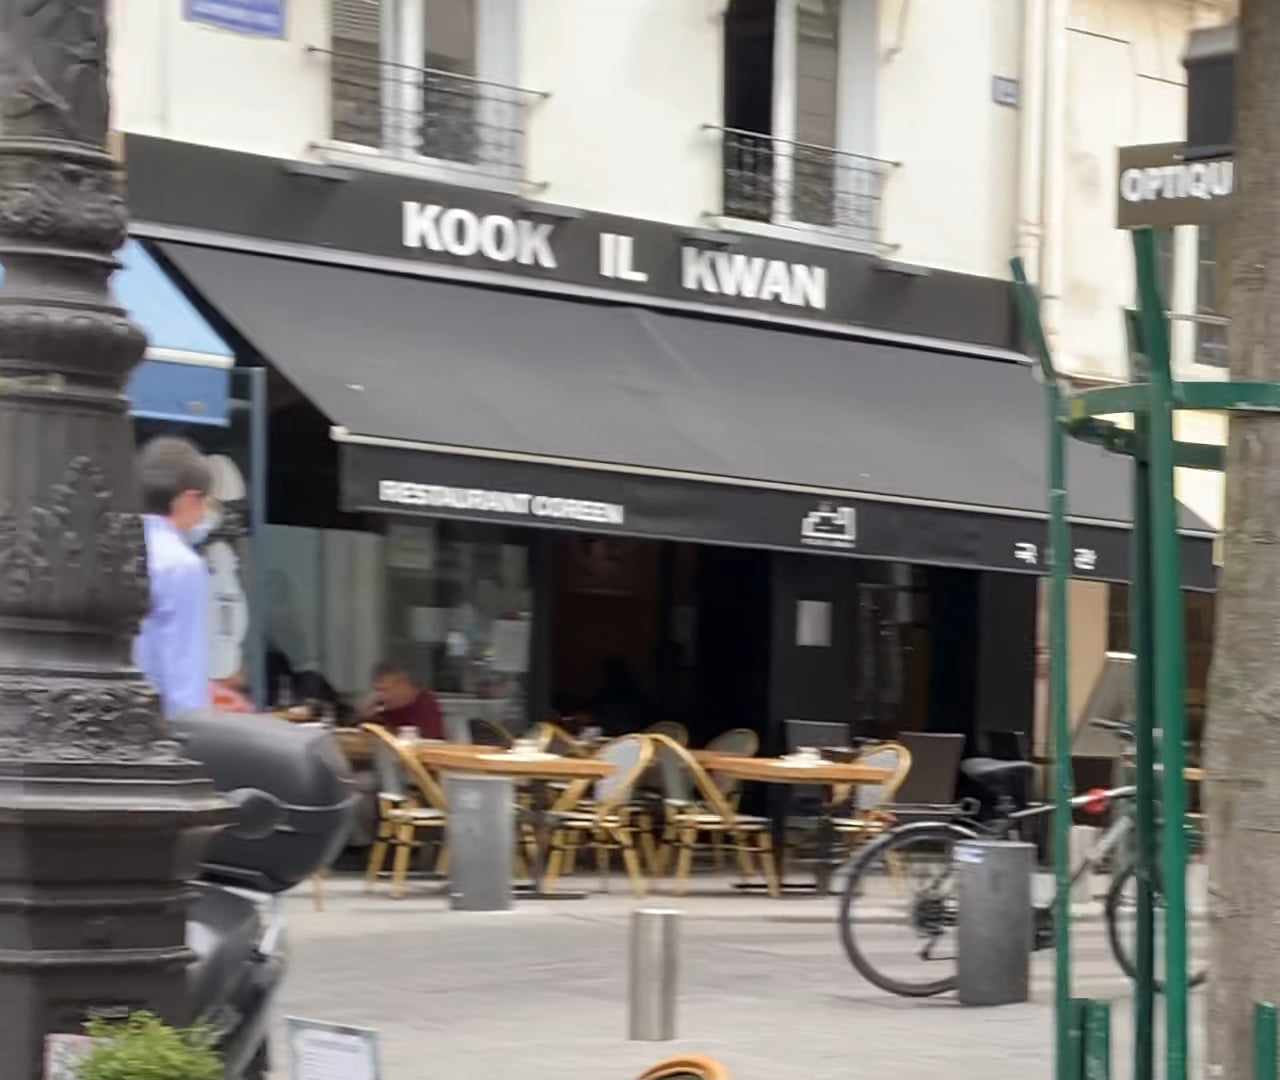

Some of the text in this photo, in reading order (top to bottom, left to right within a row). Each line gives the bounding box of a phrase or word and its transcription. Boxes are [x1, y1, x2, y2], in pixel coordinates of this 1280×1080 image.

[1120, 161, 1234, 202] OPTIQU
[402, 201, 828, 309] KOOK IL KWAN
